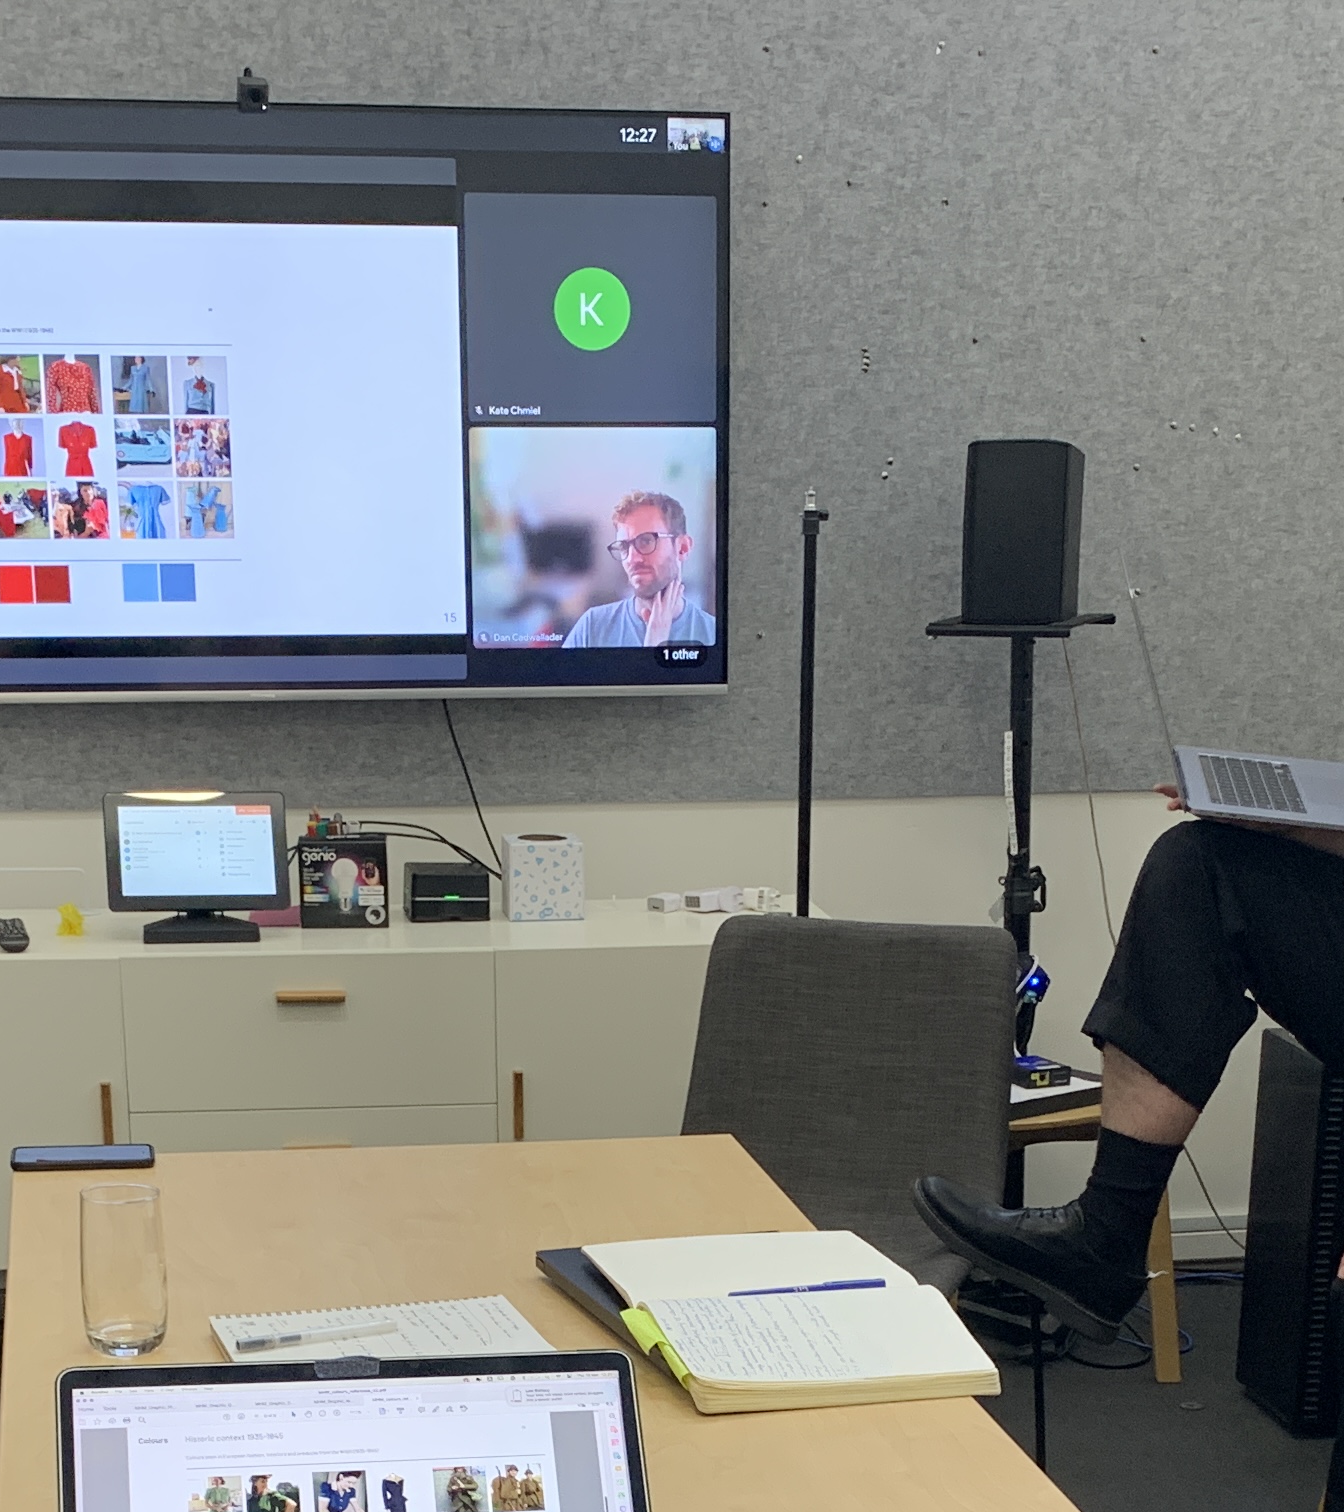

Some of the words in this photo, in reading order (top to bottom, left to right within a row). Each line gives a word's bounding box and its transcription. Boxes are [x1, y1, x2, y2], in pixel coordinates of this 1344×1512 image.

[619, 127, 657, 143] 12:27
[579, 292, 605, 326] K
[488, 405, 509, 416] Kate
[443, 612, 457, 623] 15
[493, 634, 510, 642] Dan
[663, 648, 669, 660] 1
[672, 648, 700, 660] other
[301, 851, 337, 866] genio
[138, 1436, 169, 1445] Colours
[184, 1434, 215, 1443] Historic
[216, 1434, 246, 1442] context
